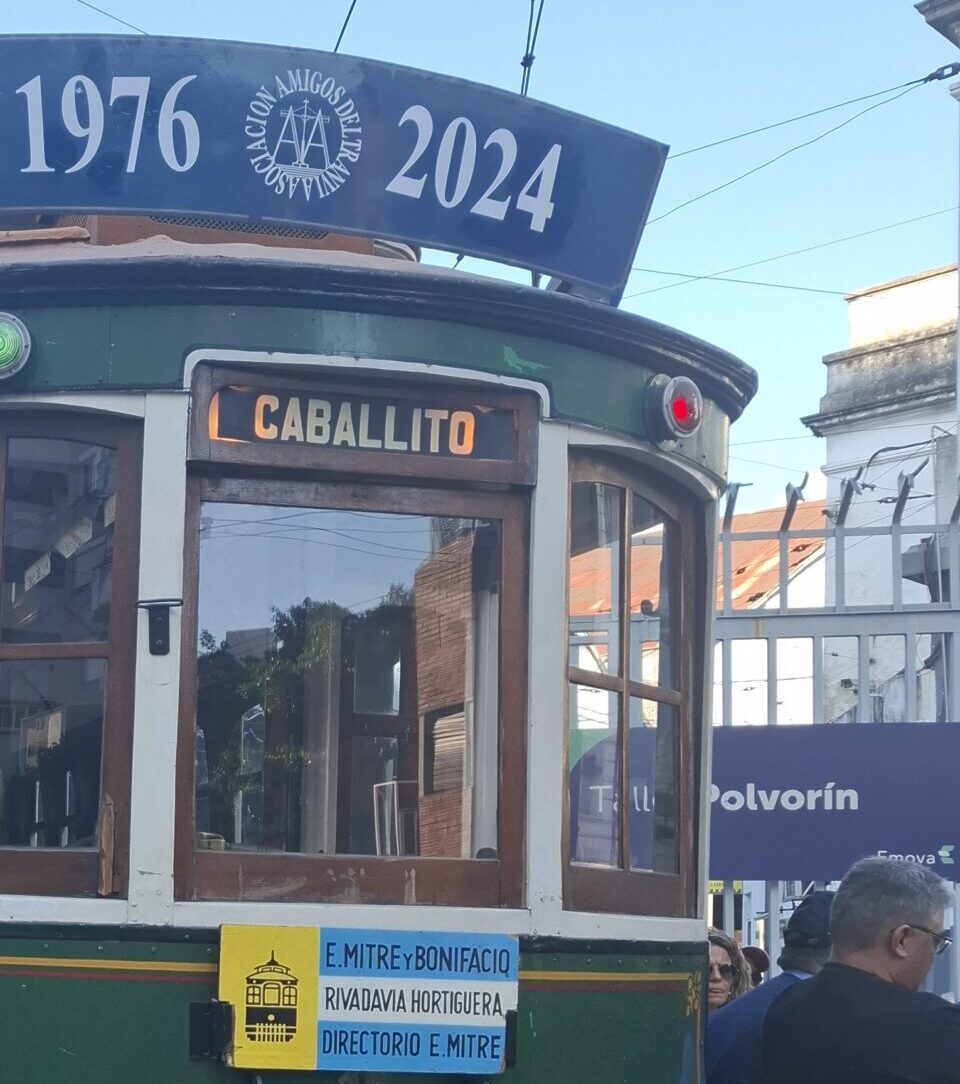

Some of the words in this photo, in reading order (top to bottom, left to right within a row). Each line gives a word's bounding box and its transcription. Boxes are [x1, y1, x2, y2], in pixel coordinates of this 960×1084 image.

[275, 69, 346, 105] AMIGOS
[16, 73, 202, 173] 1976
[385, 105, 563, 233] 2024
[254, 394, 475, 455] CABALLITO
[325, 986, 406, 1013] RIVADAVIA
[322, 1029, 421, 1057] DIRECTORIO
[429, 1033, 502, 1060] E.MITRE
